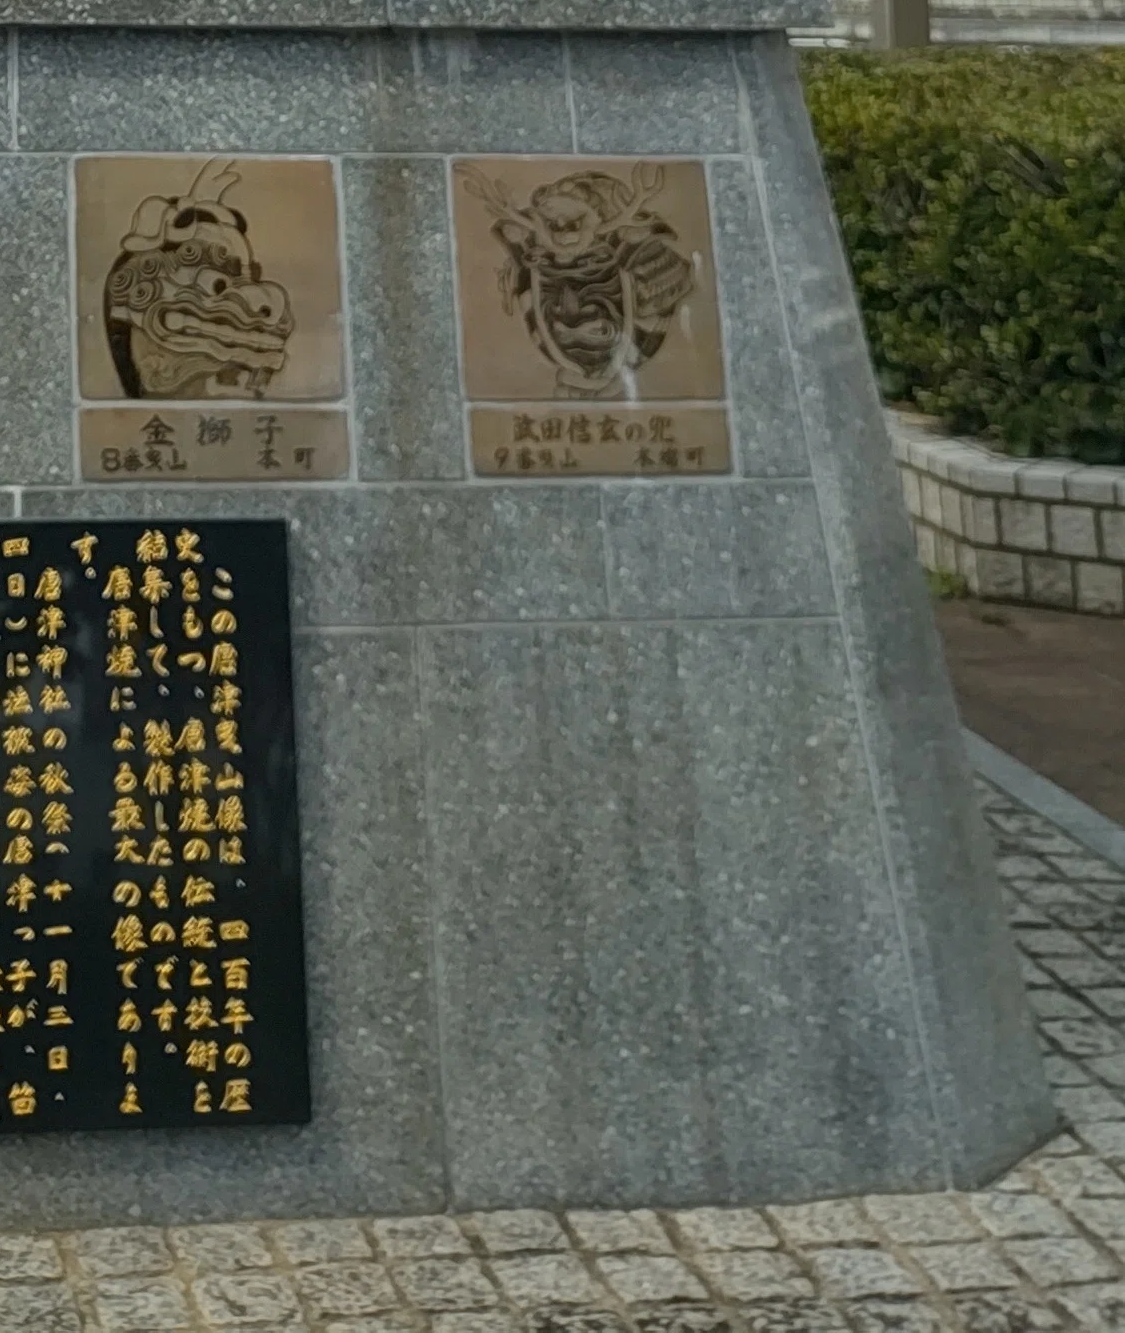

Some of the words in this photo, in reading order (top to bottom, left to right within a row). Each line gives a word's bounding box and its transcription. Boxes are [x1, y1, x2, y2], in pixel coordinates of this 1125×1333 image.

[140, 414, 283, 446] 金獅子
[70, 531, 100, 580] す。
